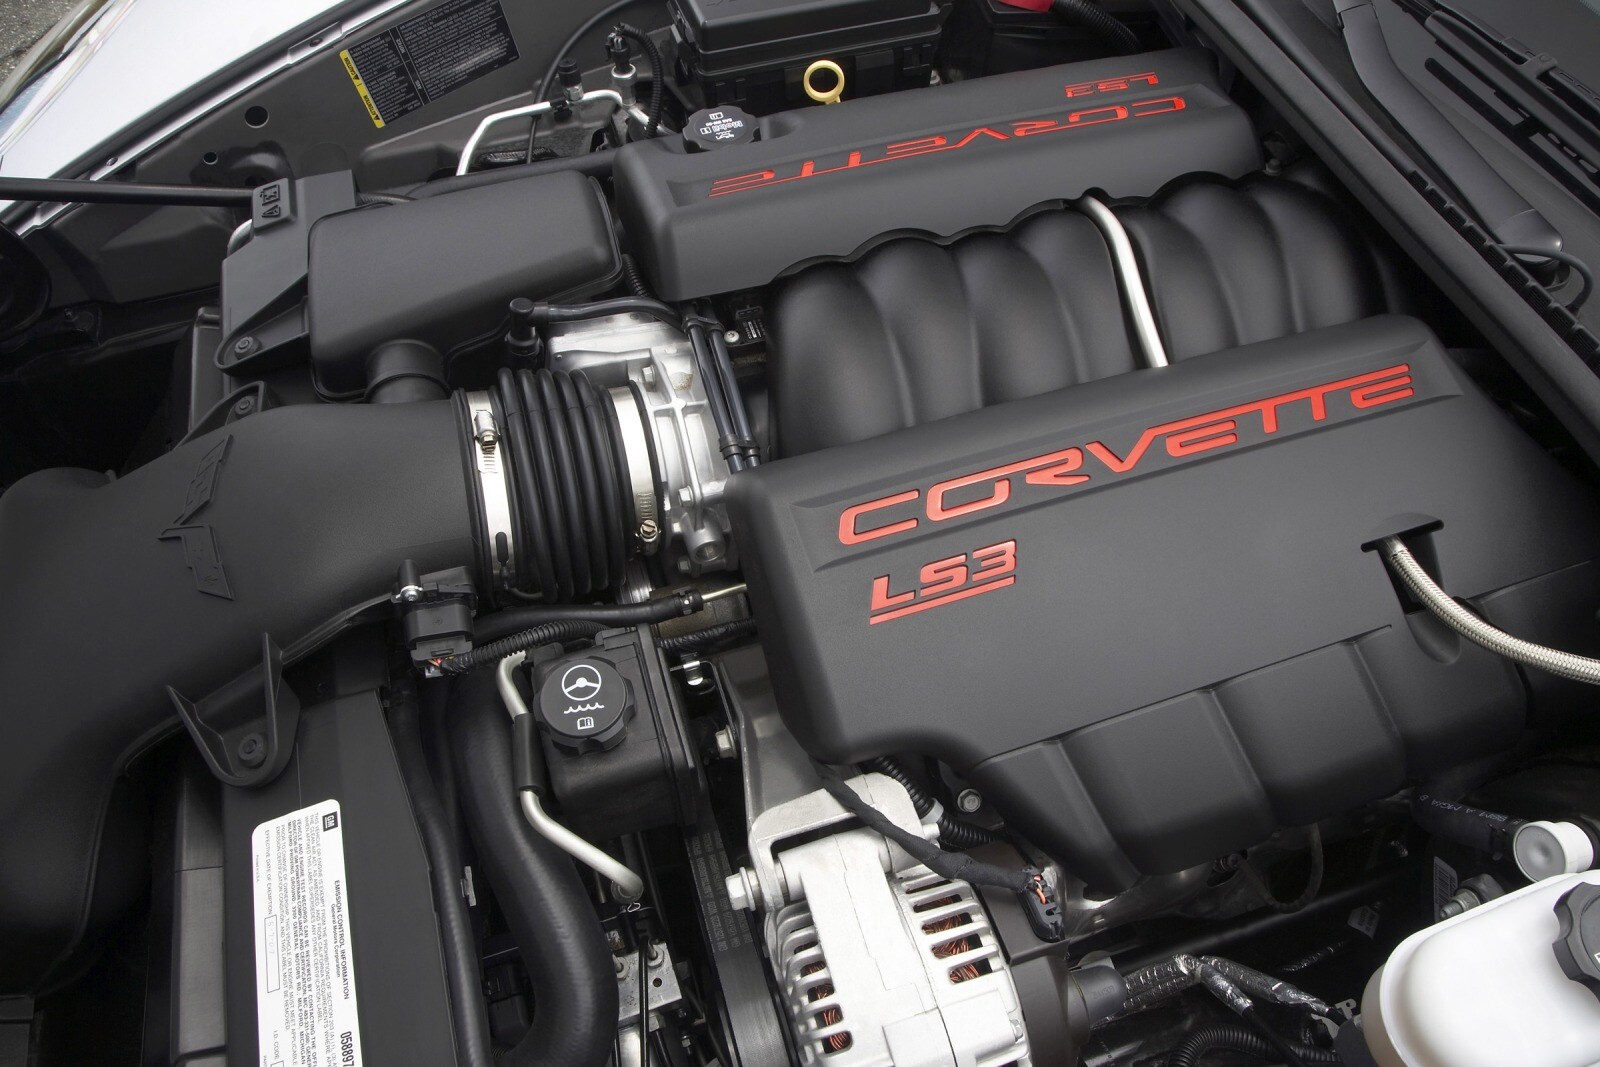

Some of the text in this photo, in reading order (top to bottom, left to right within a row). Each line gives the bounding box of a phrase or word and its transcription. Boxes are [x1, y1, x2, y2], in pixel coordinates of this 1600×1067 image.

[1065, 72, 1159, 98] LS3
[708, 96, 1187, 198] CORVETTE
[838, 363, 1414, 545] CORVETTE
[870, 538, 1017, 612] LS3
[327, 815, 335, 828] GM
[340, 949, 349, 1000] INFORMATION
[341, 1030, 354, 1067] 058897
